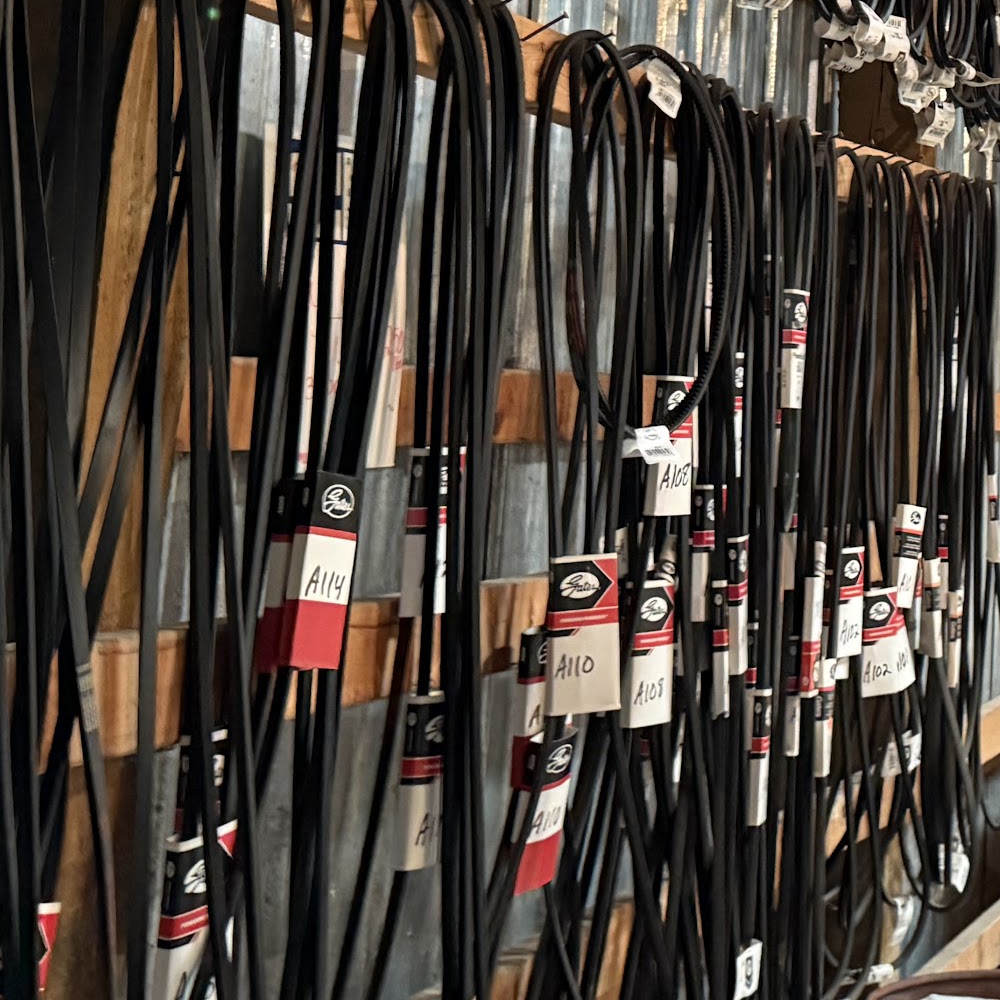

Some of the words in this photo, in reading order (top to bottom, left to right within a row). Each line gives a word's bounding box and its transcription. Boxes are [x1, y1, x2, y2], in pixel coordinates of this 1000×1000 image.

[659, 462, 691, 491] A108
[304, 565, 346, 600] A114
[560, 572, 600, 599] Gates
[555, 653, 595, 680] A110
[863, 660, 892, 684] A102
[633, 677, 665, 705] A108
